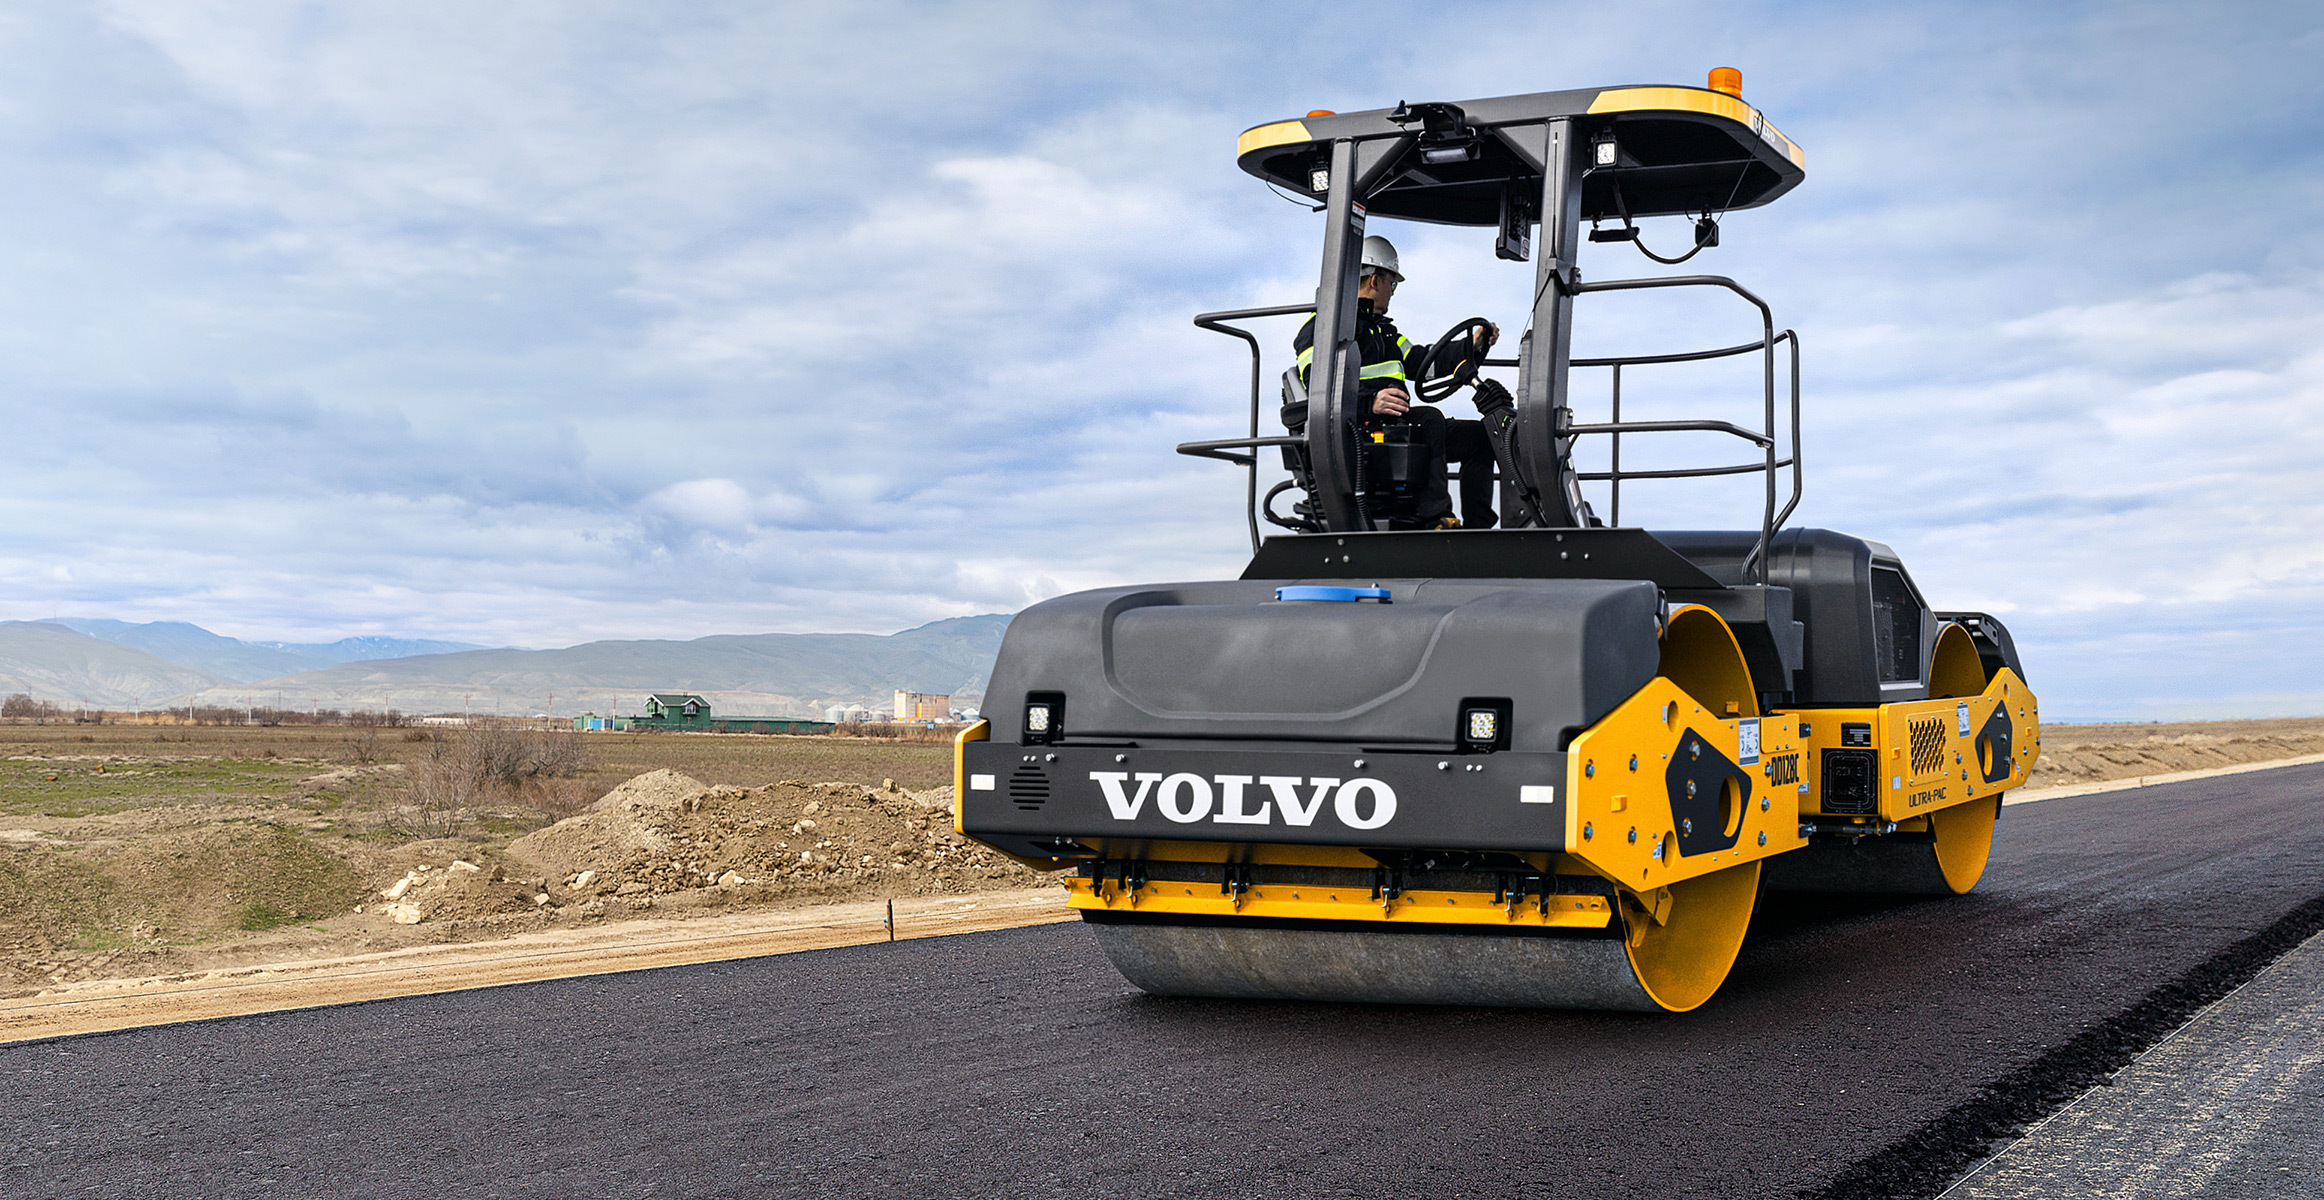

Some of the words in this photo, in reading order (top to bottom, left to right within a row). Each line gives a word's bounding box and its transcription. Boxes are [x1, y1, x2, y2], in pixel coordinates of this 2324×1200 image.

[1771, 753, 1800, 788] DD128C
[1089, 771, 1398, 830] VOLVO
[1908, 786, 1947, 808] ULTRA-PAC
